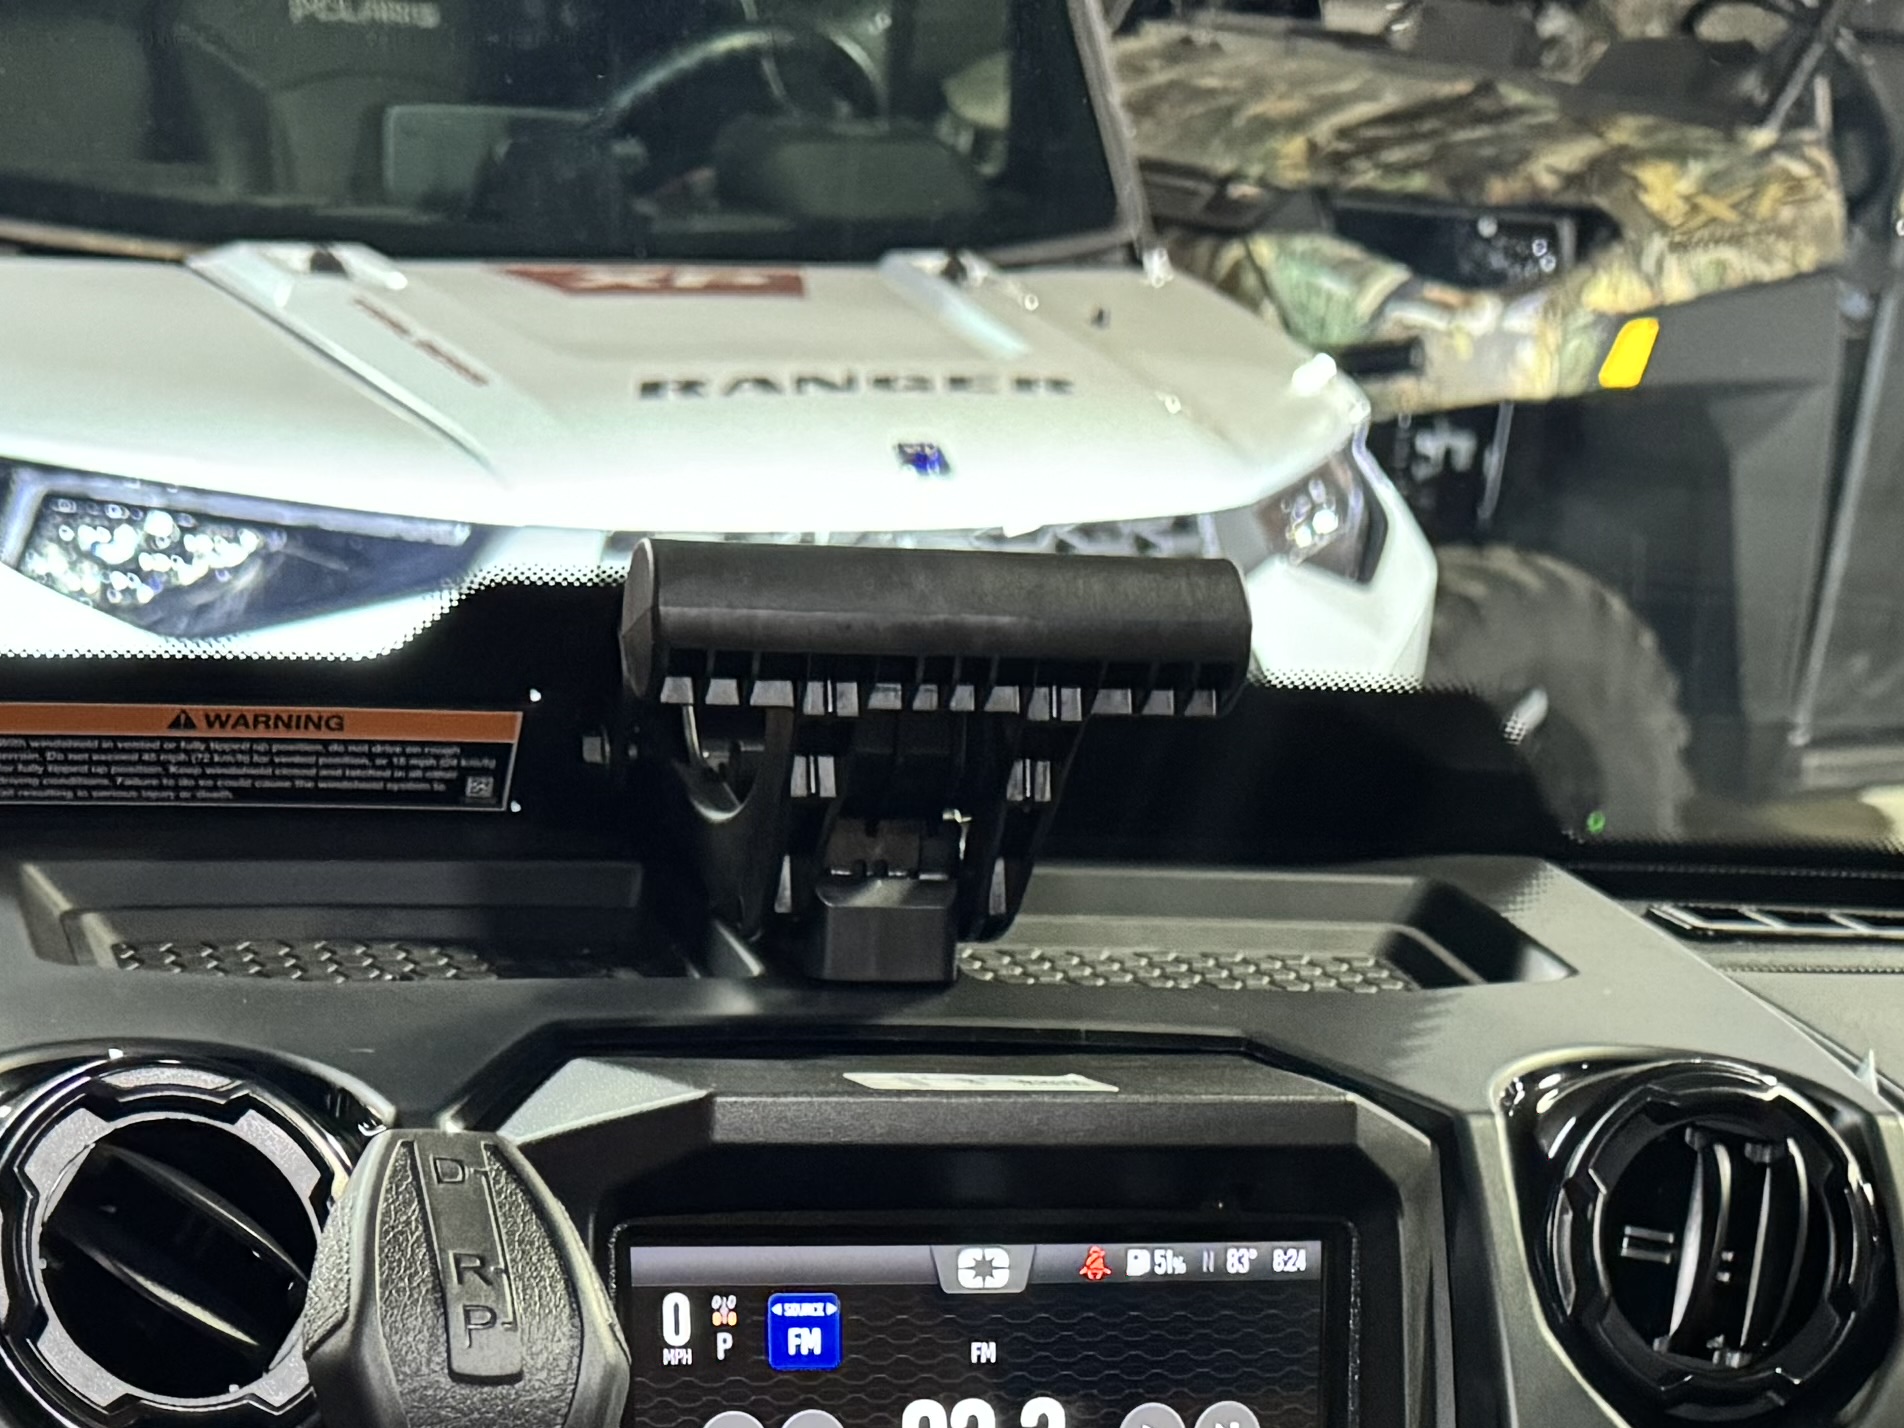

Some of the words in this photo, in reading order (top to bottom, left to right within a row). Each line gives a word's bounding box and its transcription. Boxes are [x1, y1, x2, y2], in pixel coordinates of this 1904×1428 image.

[638, 374, 1076, 400] RANGER
[205, 712, 345, 732] WARNING
[433, 1157, 466, 1185] D
[451, 1252, 493, 1286] R
[1272, 1248, 1307, 1273] 8:24
[462, 1304, 497, 1349] P
[662, 1292, 691, 1347] 0
[716, 1332, 733, 1361] P
[787, 1328, 822, 1356] FM
[970, 1342, 997, 1364] FM
[662, 1349, 693, 1366] MPH
